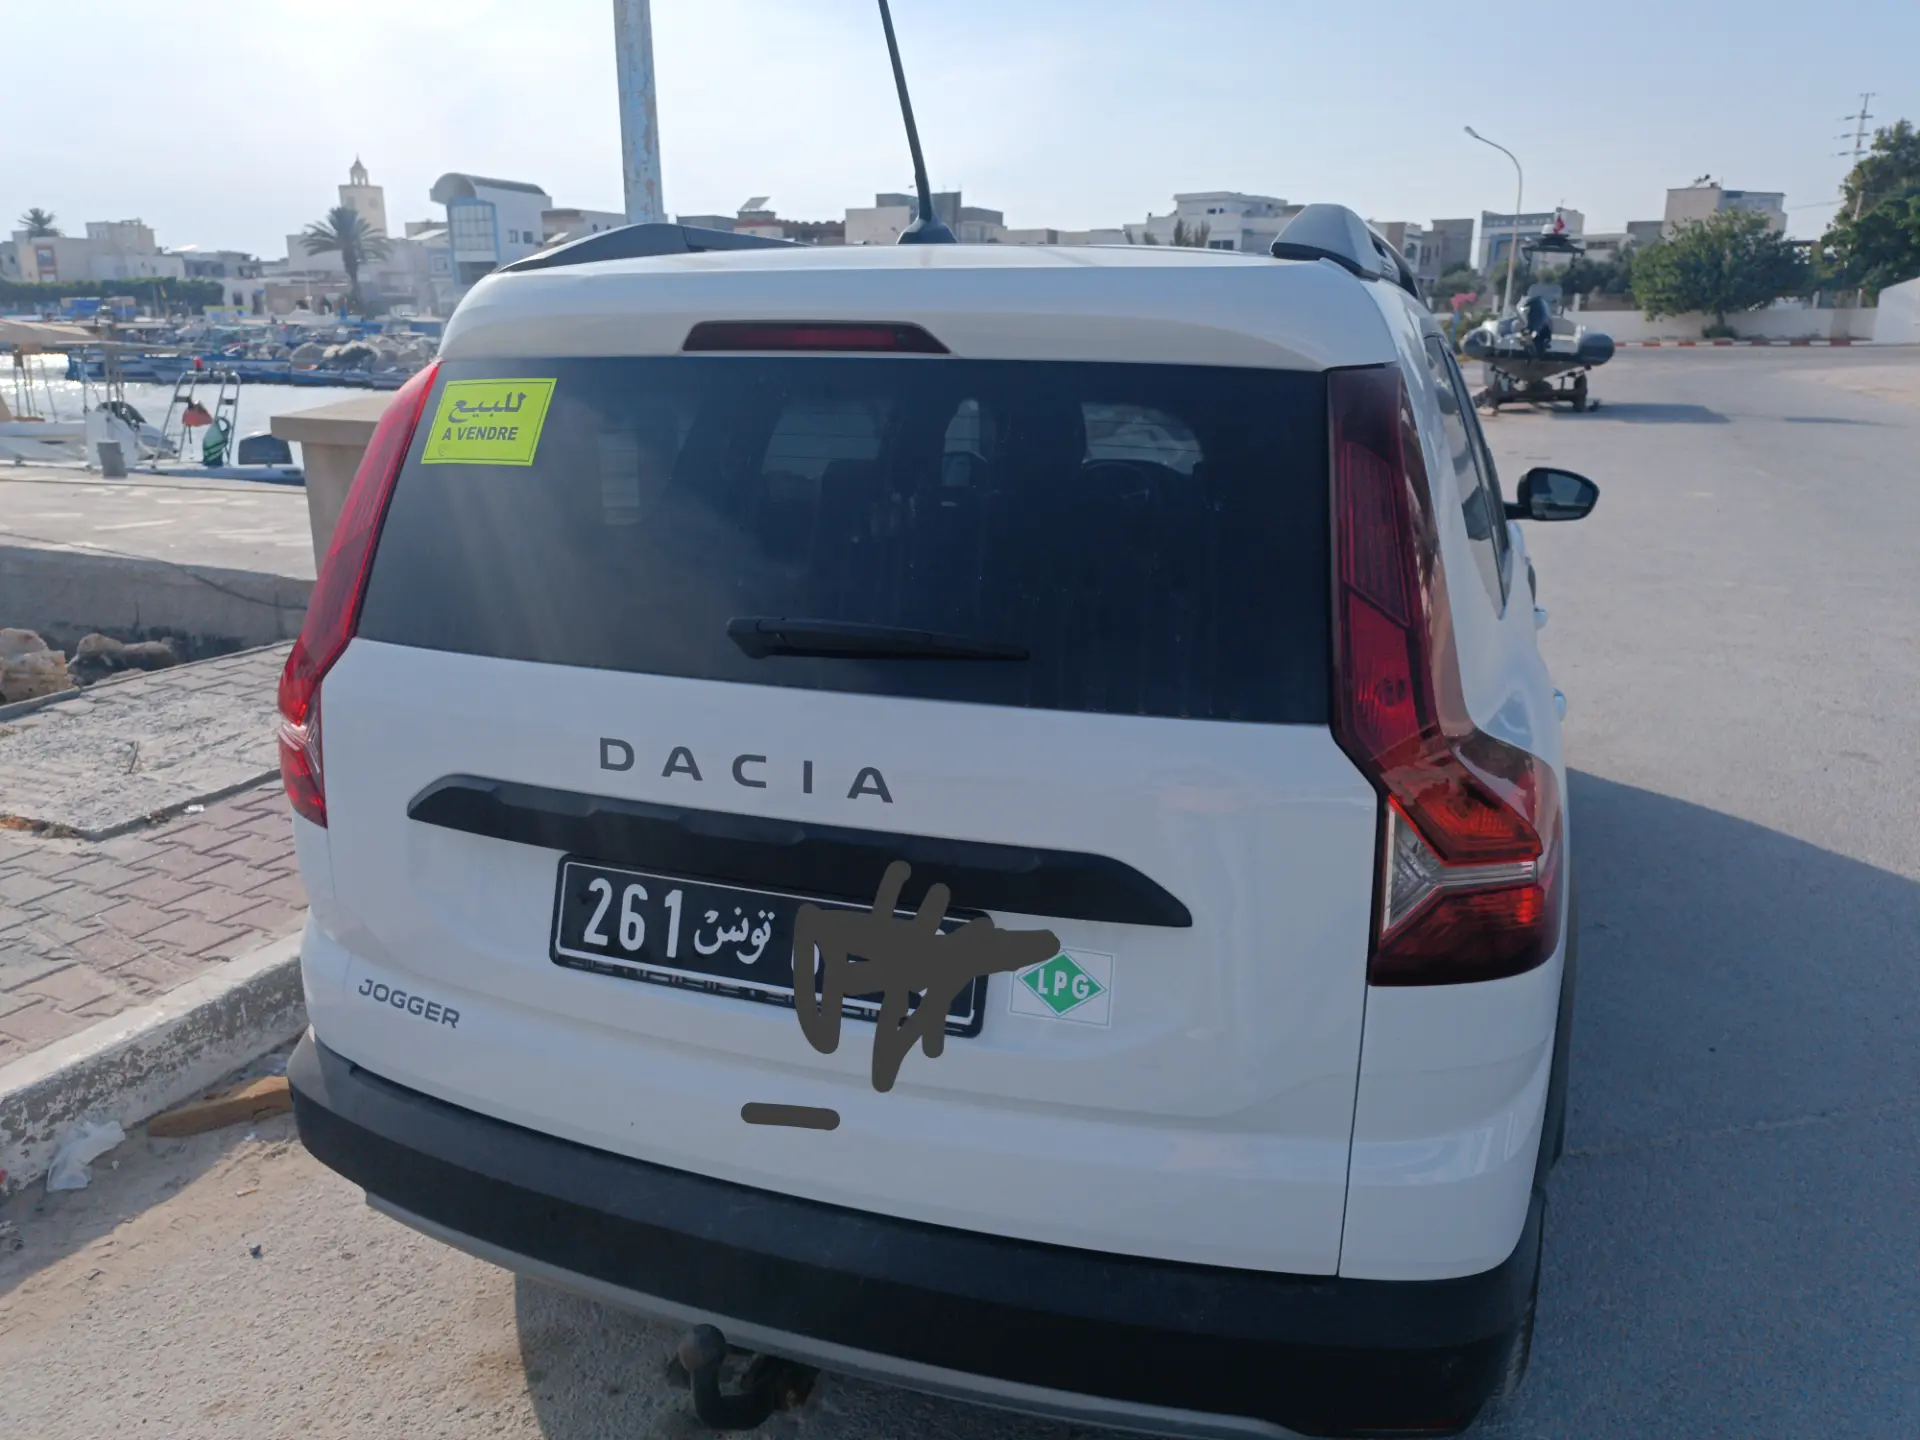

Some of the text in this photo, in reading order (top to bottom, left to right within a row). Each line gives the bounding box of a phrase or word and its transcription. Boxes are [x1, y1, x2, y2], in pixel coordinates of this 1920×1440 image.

[448, 391, 527, 423] للبيع
[441, 426, 519, 441] A VENDRE
[600, 737, 894, 804] DACIA
[583, 877, 683, 959] 261
[694, 906, 776, 965] تونس
[358, 978, 461, 1029] JOGGER
[1037, 968, 1090, 1000] LPG
